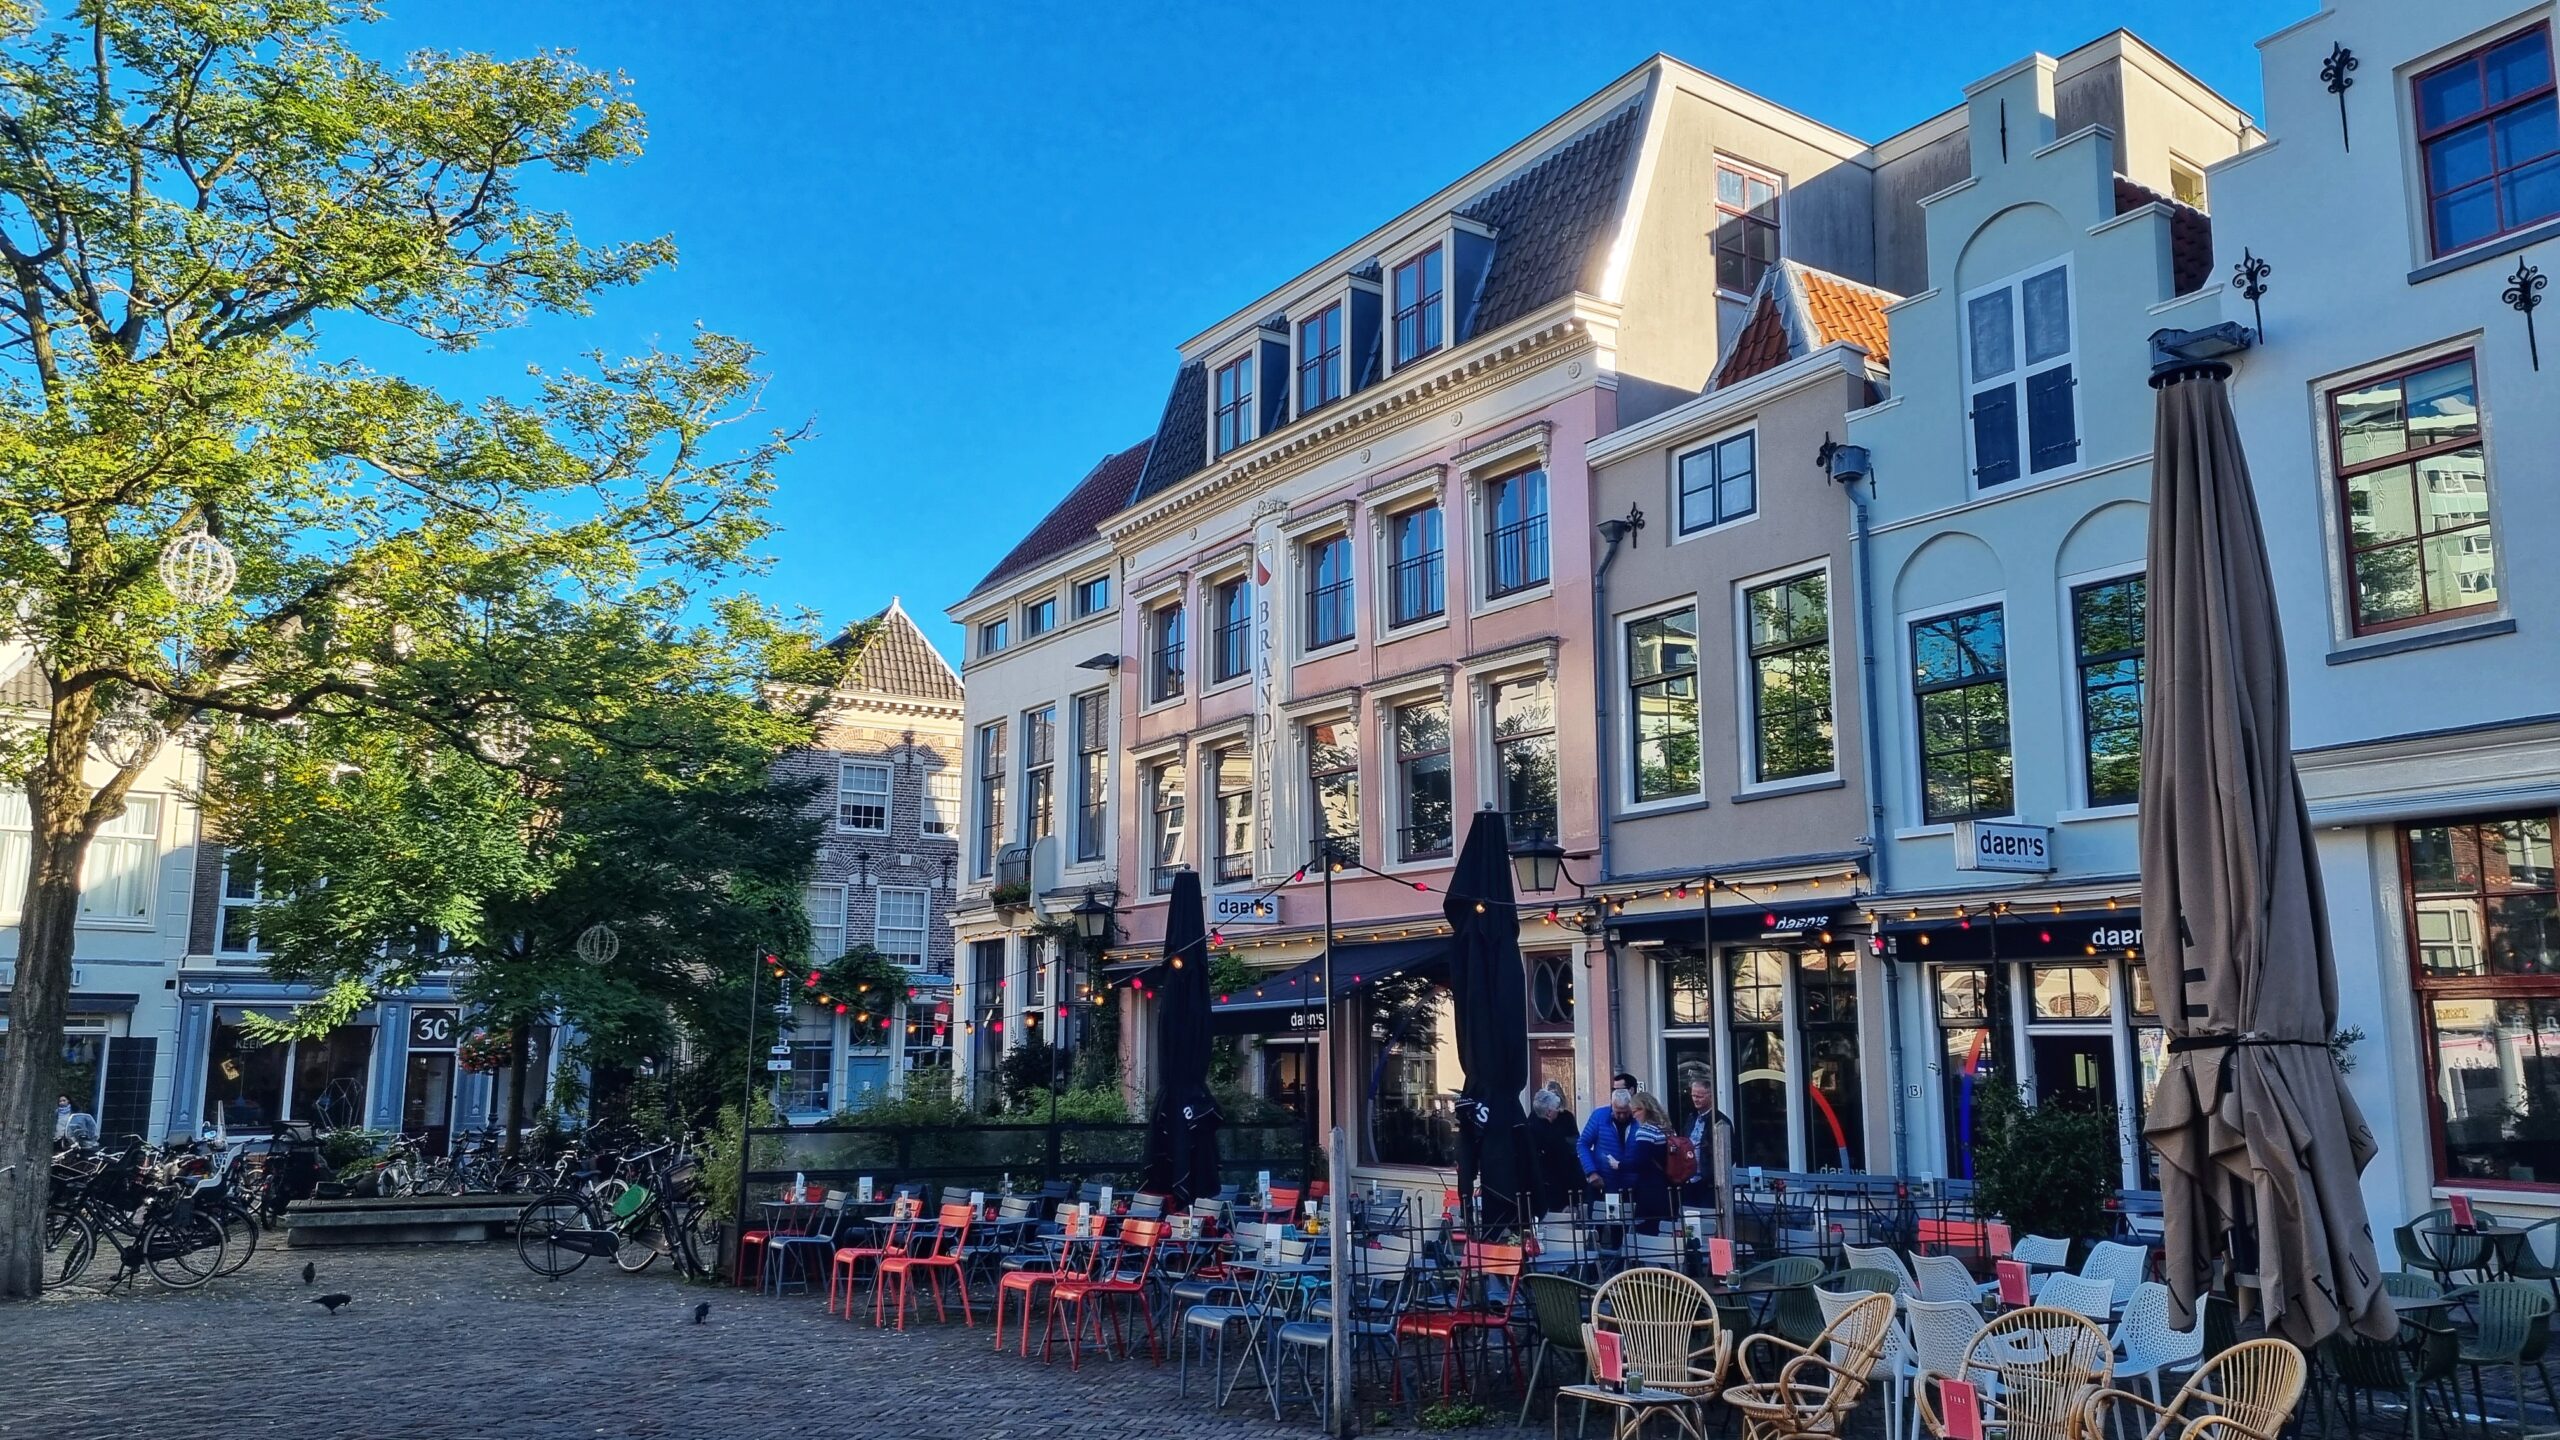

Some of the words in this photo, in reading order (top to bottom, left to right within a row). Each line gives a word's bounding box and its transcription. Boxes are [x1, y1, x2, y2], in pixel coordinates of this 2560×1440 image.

[1259, 600, 1277, 850] BRANDWEER
[1980, 829, 2044, 857] daen's
[1218, 898, 1274, 914] daens
[1909, 1085, 1919, 1097] 13
